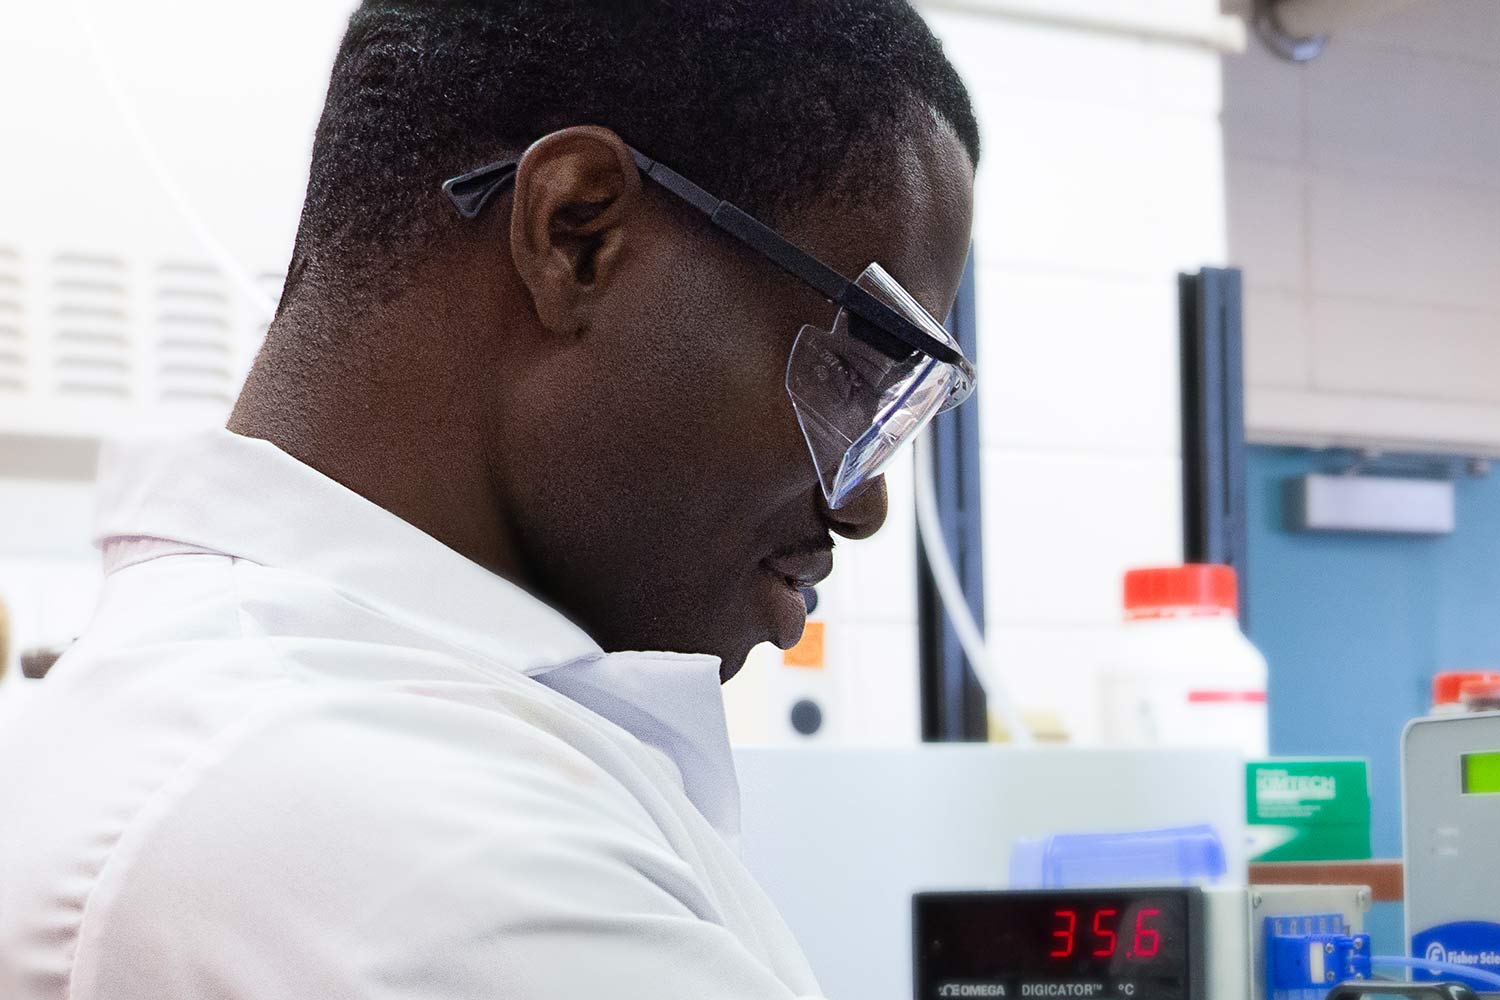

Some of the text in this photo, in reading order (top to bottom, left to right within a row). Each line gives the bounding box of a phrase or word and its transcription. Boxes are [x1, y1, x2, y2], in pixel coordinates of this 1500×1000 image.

[1048, 908, 1161, 959] 35.6
[1448, 951, 1478, 965] Fisher
[1118, 983, 1135, 996] °C
